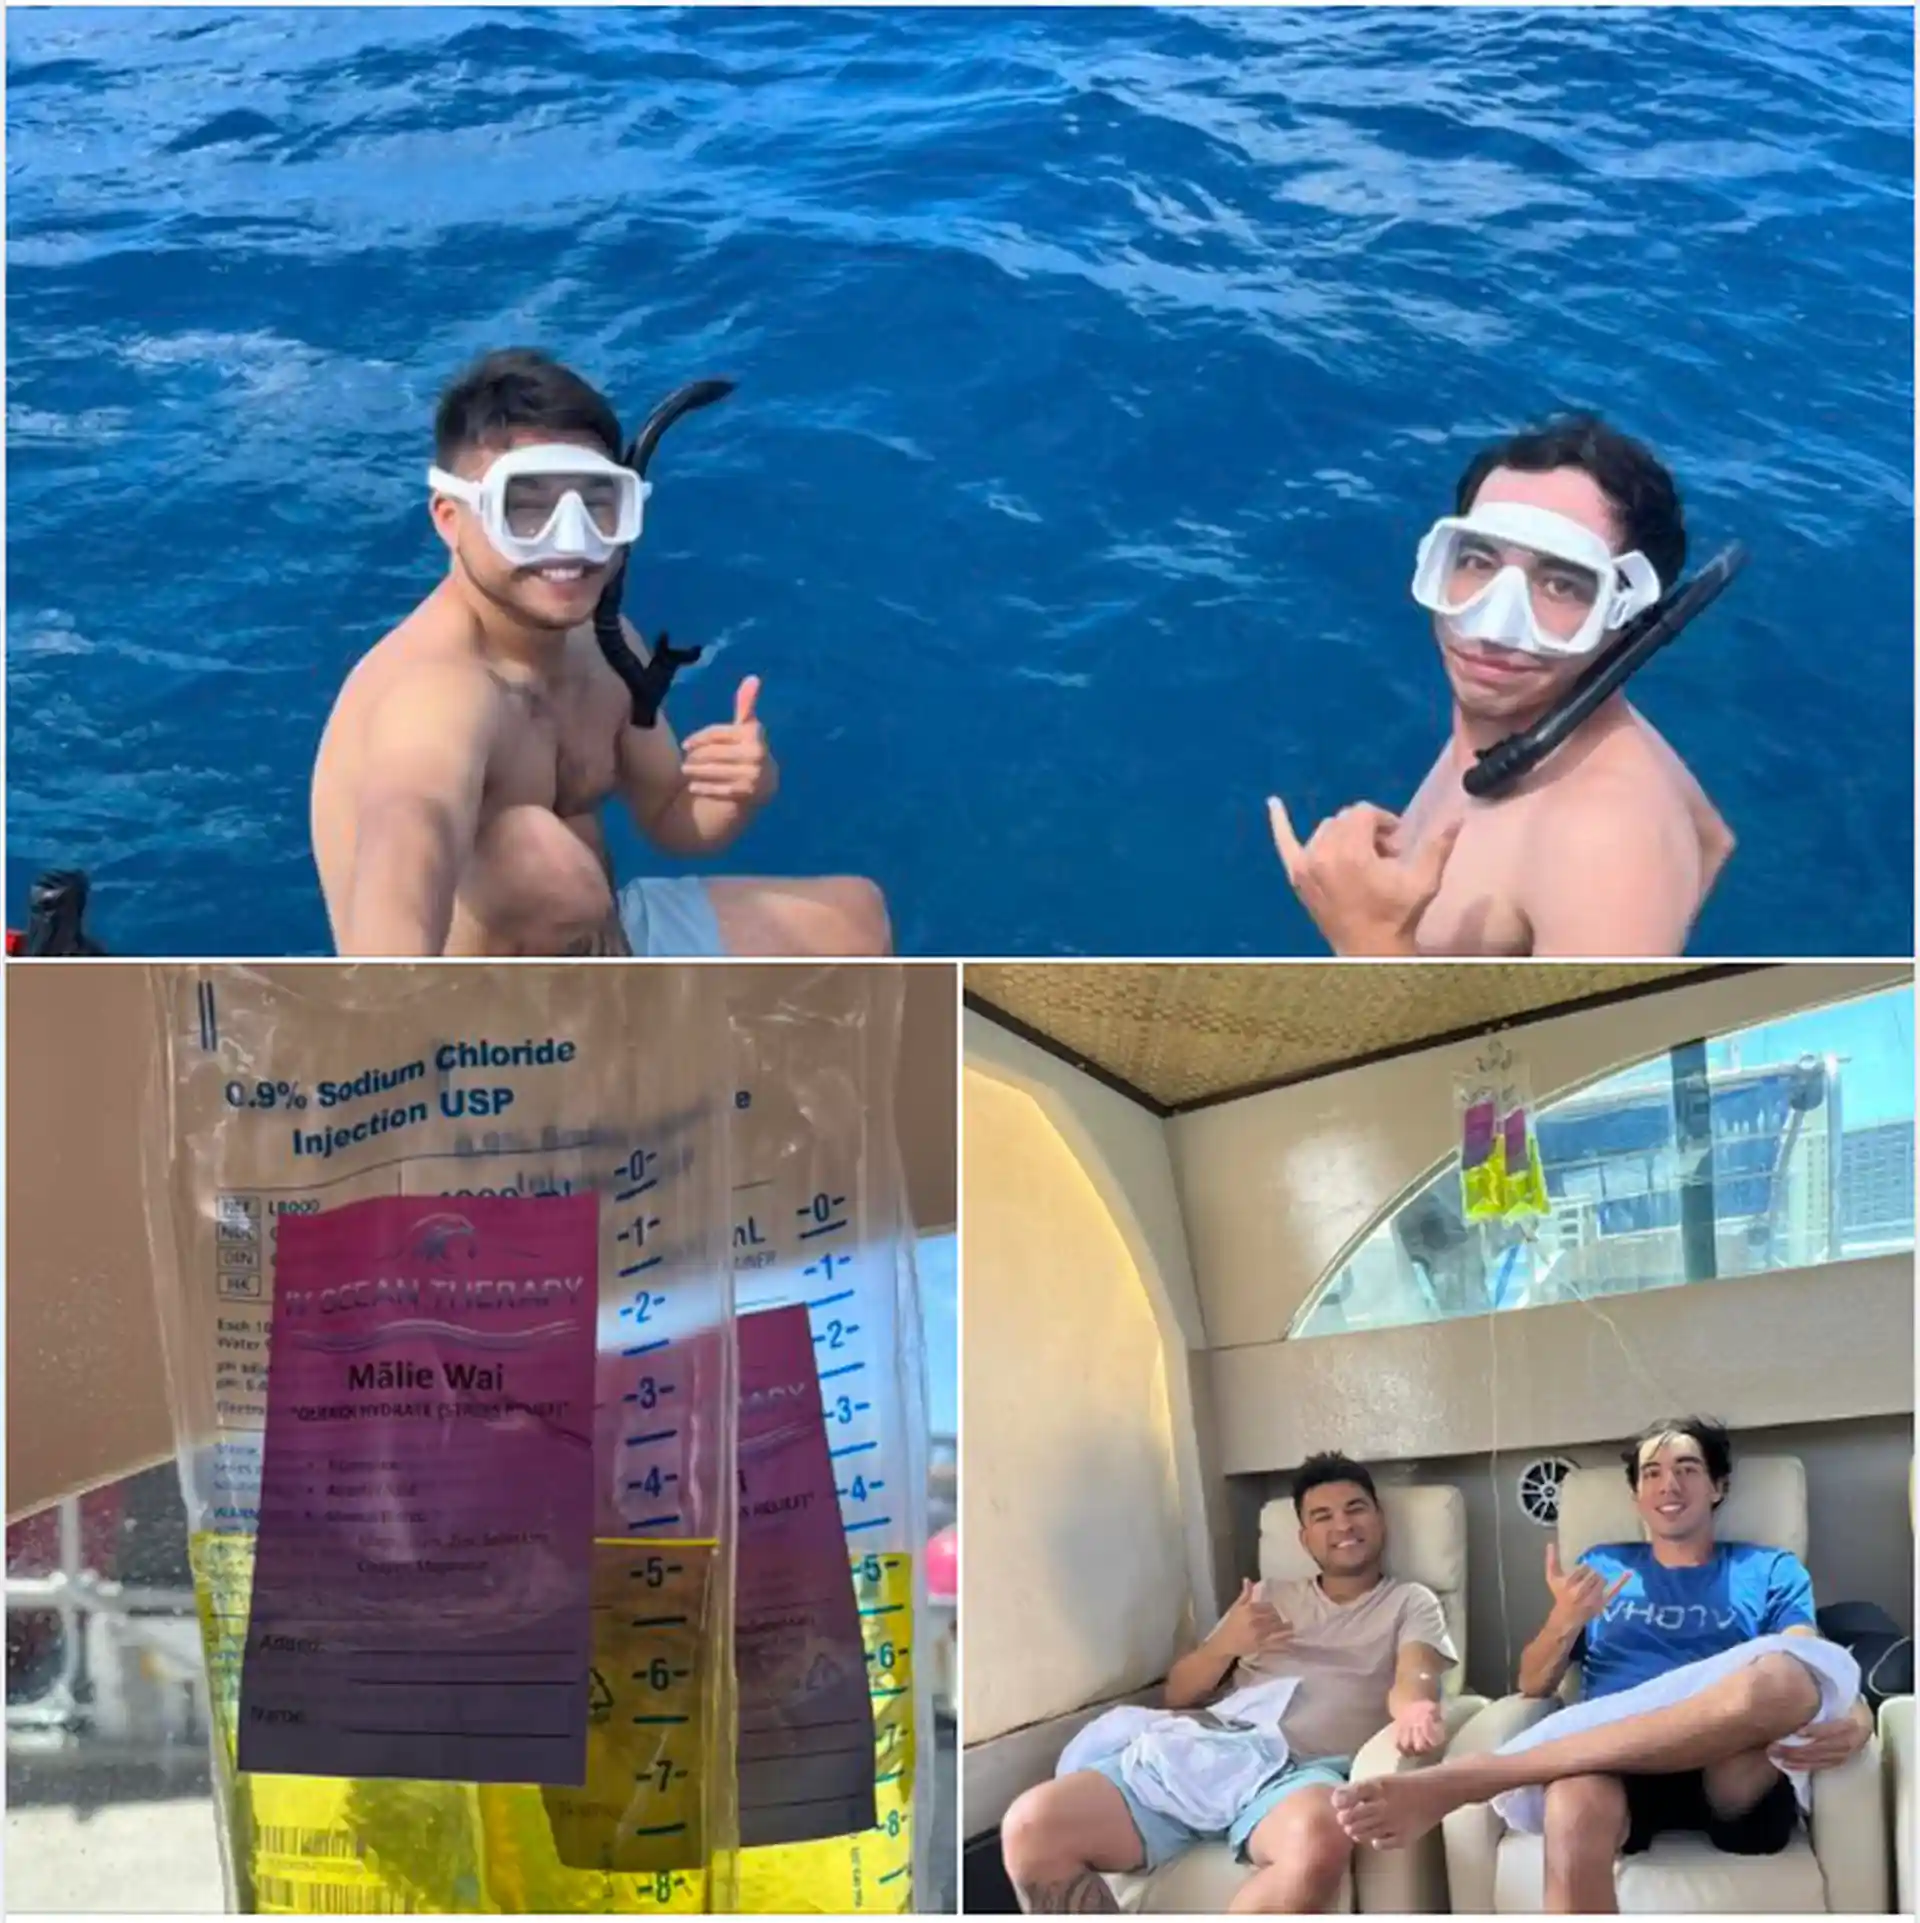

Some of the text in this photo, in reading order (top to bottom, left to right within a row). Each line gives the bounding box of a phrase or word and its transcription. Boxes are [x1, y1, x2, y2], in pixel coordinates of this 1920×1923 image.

[225, 1038, 576, 1111] 0.9% Sodium Chloride
[292, 1101, 428, 1158] Injection
[439, 1087, 515, 1118] USP
[444, 1362, 504, 1391] Wai
